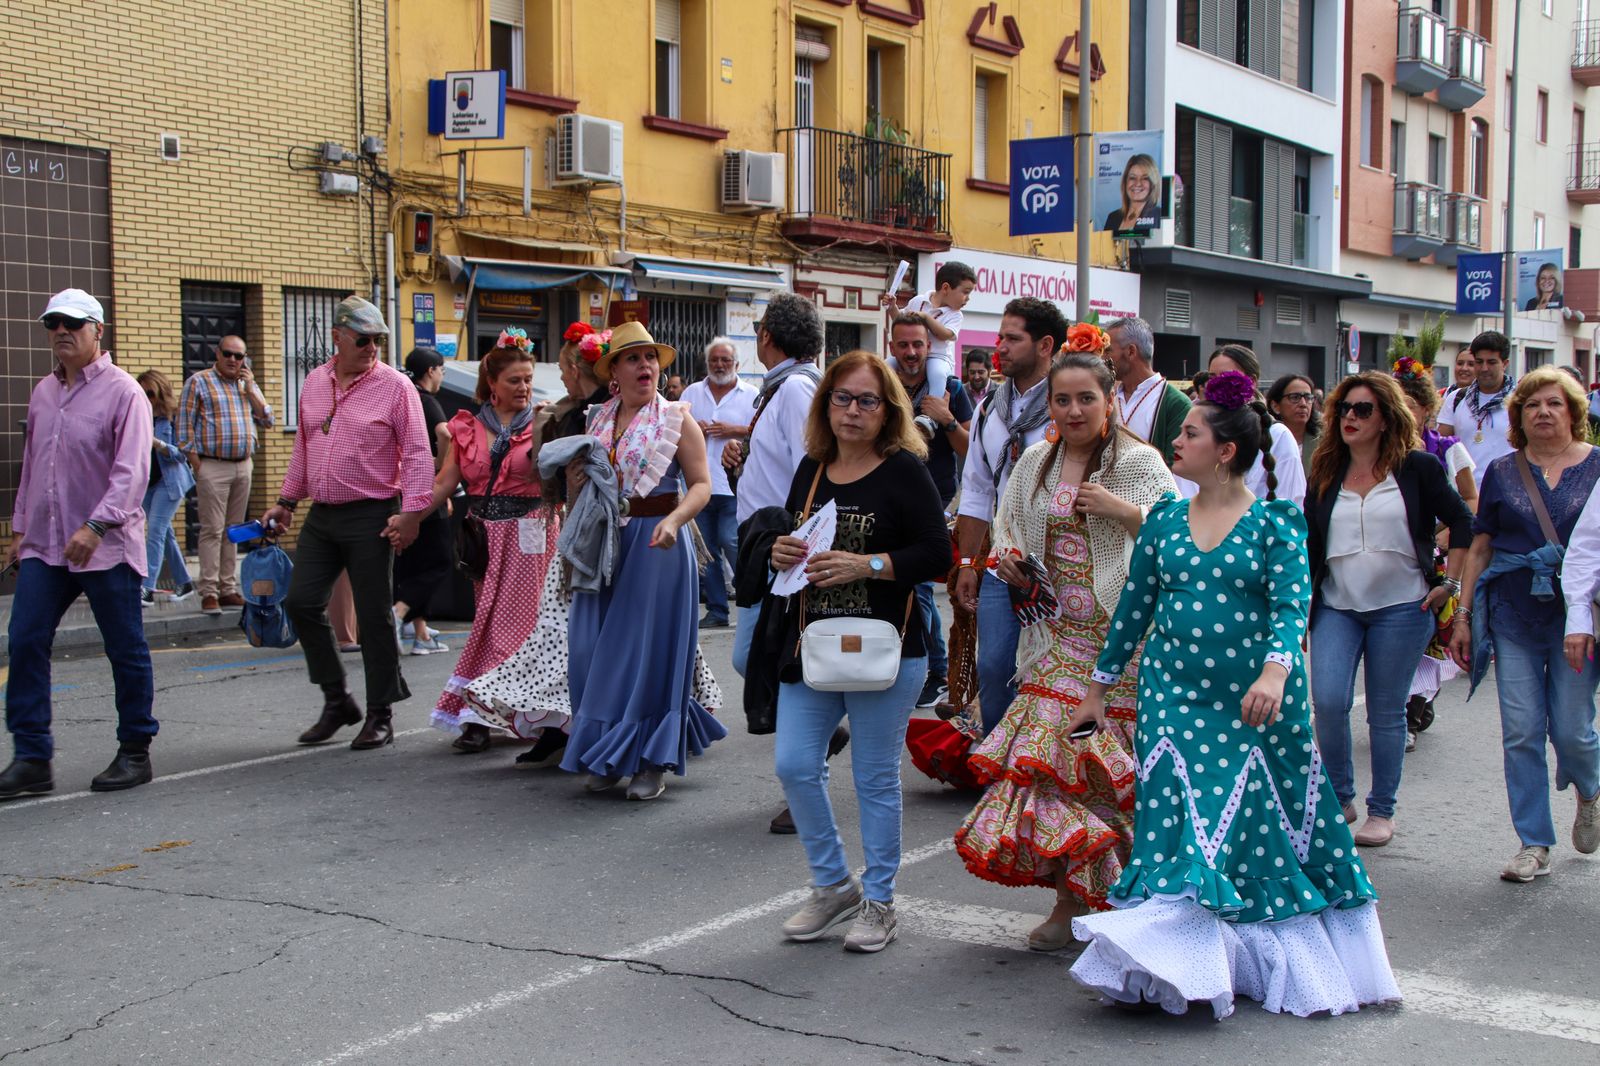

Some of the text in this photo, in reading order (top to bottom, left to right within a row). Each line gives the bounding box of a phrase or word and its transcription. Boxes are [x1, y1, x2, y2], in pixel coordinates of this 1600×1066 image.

[1022, 165, 1060, 180] VOTA
[1137, 217, 1155, 225] 28M
[1466, 270, 1493, 280] VOTA
[1001, 269, 1017, 296] LA
[1020, 270, 1076, 302] ESTACIÓN
